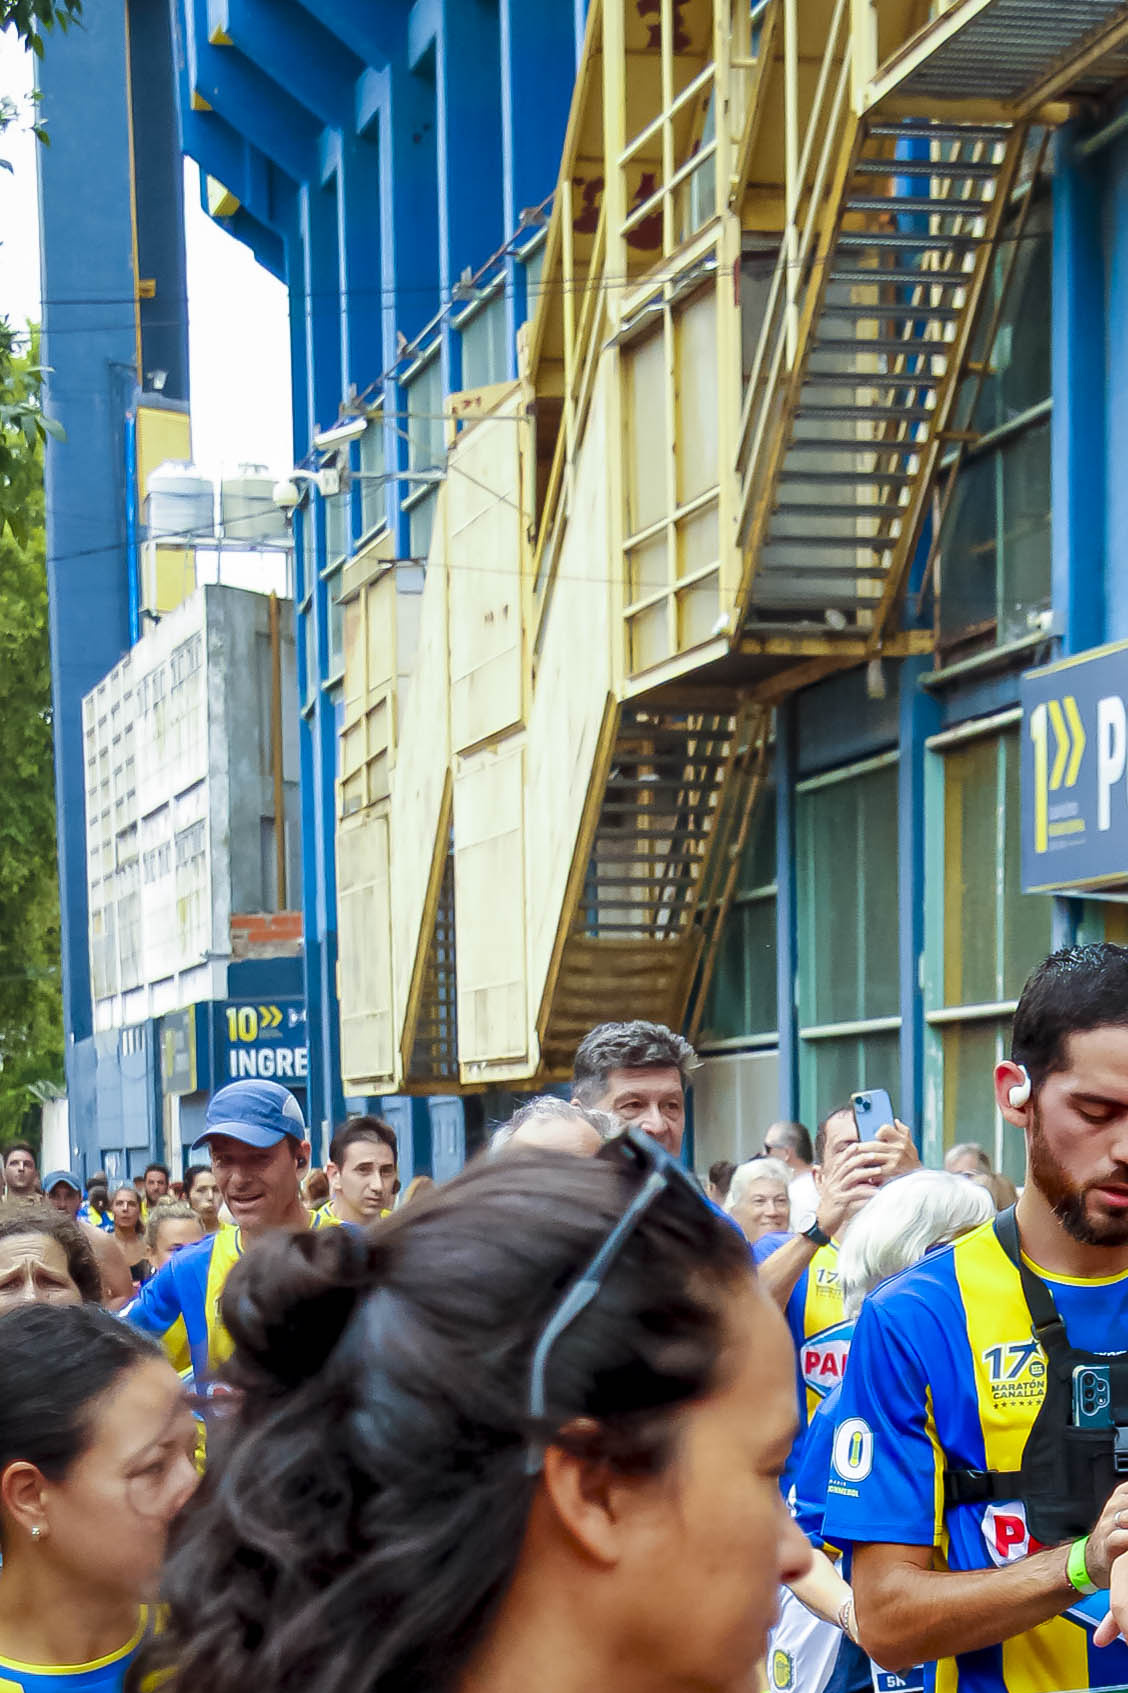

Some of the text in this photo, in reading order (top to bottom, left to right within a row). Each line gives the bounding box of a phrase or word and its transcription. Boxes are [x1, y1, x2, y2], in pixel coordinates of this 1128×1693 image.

[226, 1006, 258, 1042] 10
[230, 1047, 309, 1077] INGRE
[984, 1341, 1040, 1380] 17
[991, 1380, 1045, 1392] MARATÓN
[993, 1389, 1045, 1400] CANALLA
